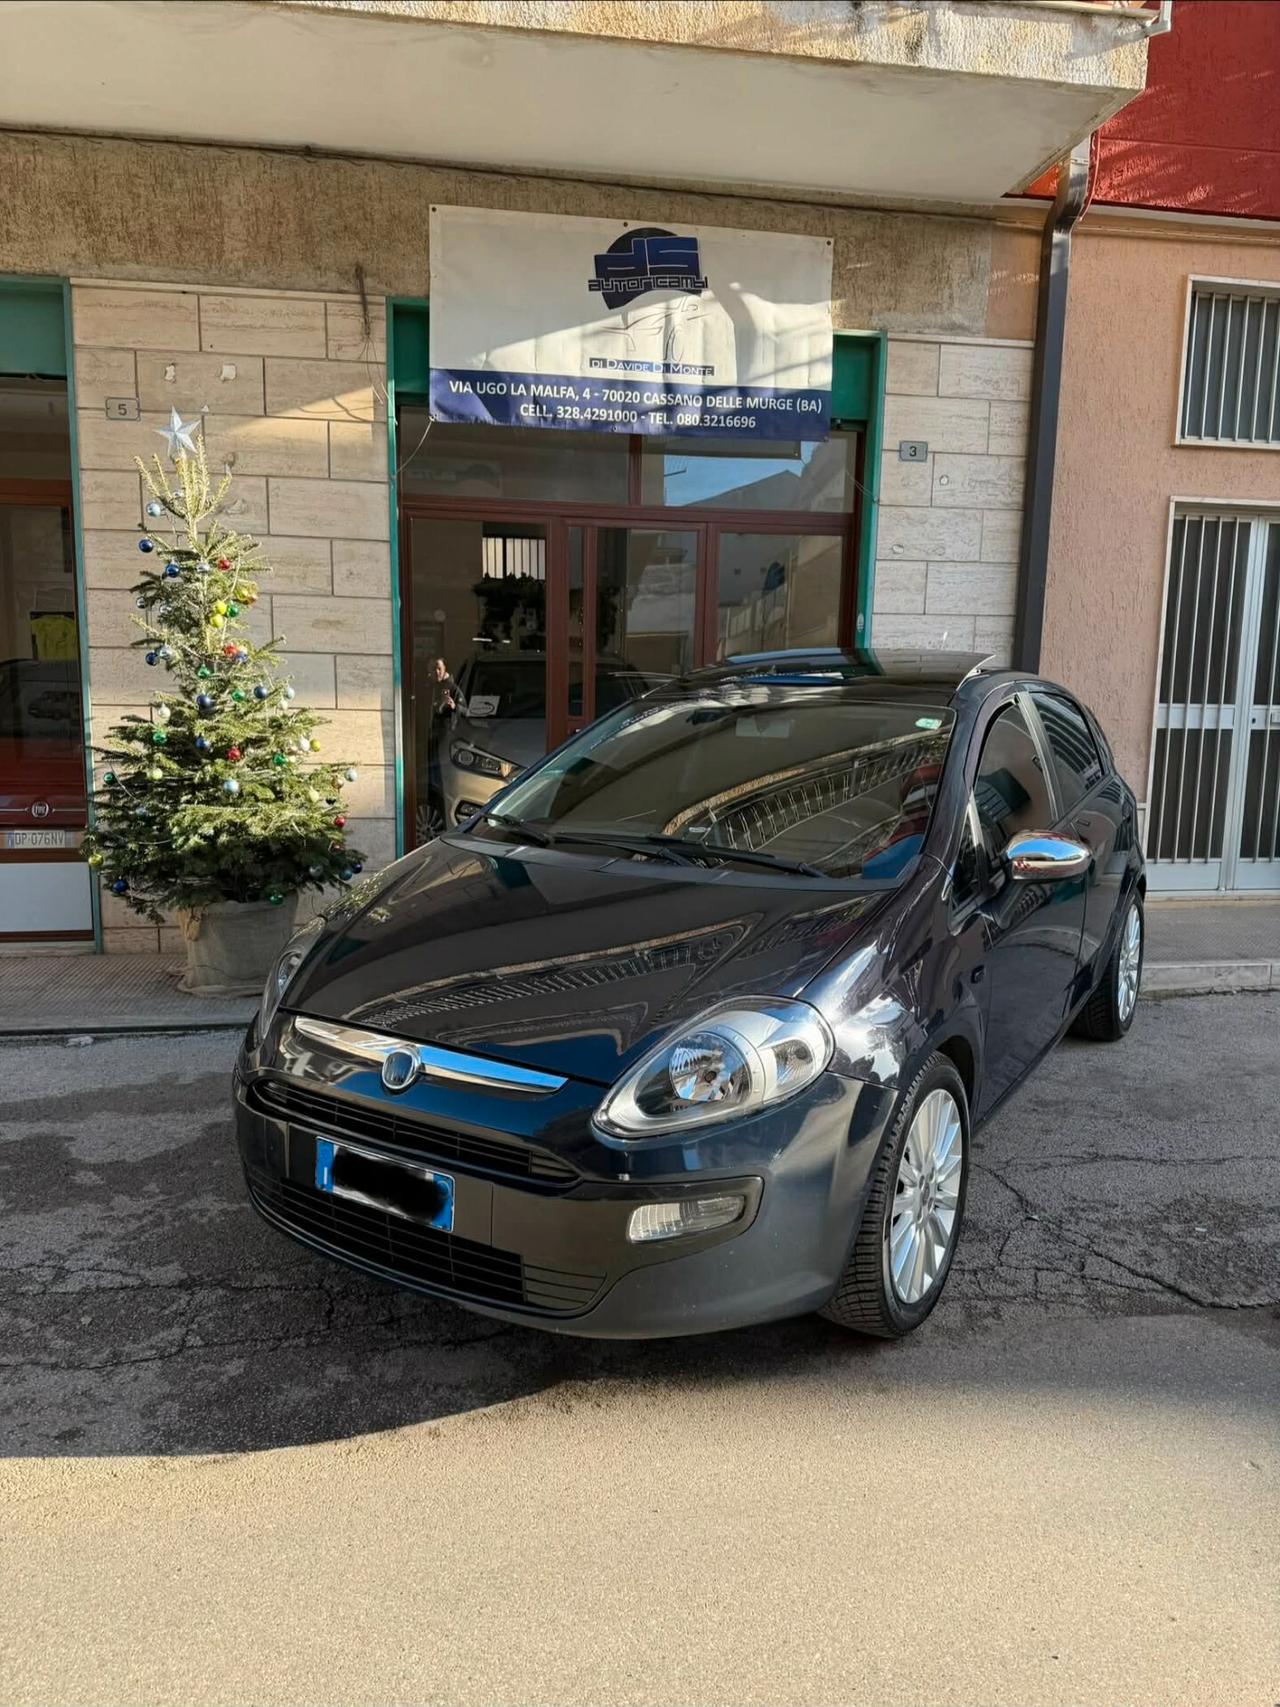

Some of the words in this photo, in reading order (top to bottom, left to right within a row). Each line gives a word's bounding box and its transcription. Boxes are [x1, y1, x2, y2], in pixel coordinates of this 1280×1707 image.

[606, 359, 650, 372] DAVIDE
[669, 364, 713, 376] MONTE
[449, 380, 473, 394] VIA
[476, 382, 507, 396] UGO
[510, 383, 527, 396] LA
[530, 384, 579, 401] MALFA,
[582, 387, 591, 400] 4
[602, 388, 640, 404] 70020
[643, 391, 703, 408] CASSANO
[706, 395, 743, 409] DELLE
[746, 397, 793, 411] MURGE
[796, 398, 823, 414] (BA)
[118, 403, 127, 416] 5
[520, 403, 553, 418] CELL.
[556, 406, 638, 424] 328.4291000
[649, 411, 673, 426] TEL.
[677, 413, 757, 429] 080.3216696
[909, 445, 917, 457] 3
